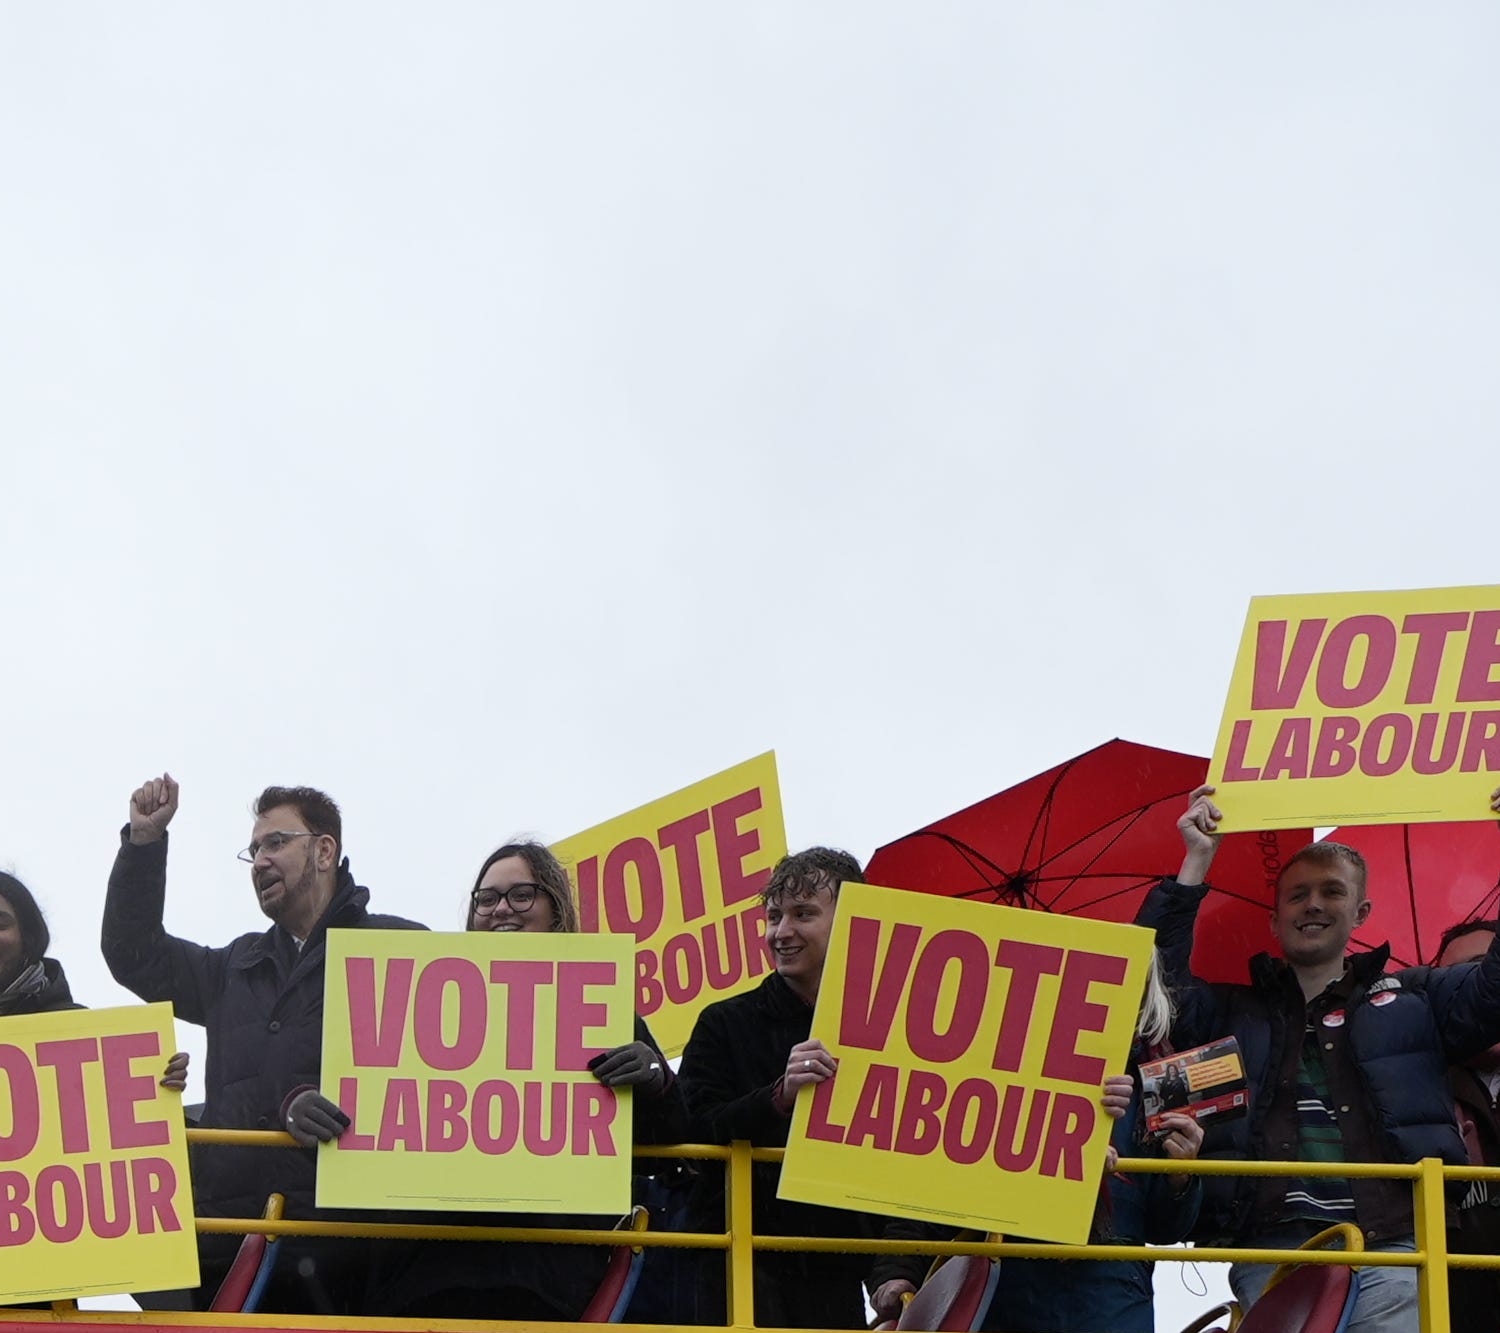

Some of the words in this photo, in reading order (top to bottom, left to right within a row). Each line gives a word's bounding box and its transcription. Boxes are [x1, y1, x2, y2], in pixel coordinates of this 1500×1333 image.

[346, 957, 617, 1071] VOTE
[636, 905, 777, 1017] BOUR
[839, 916, 1129, 1085] VOTE
[337, 1077, 618, 1156] LABOUR
[805, 1058, 1096, 1181] LABOUR
